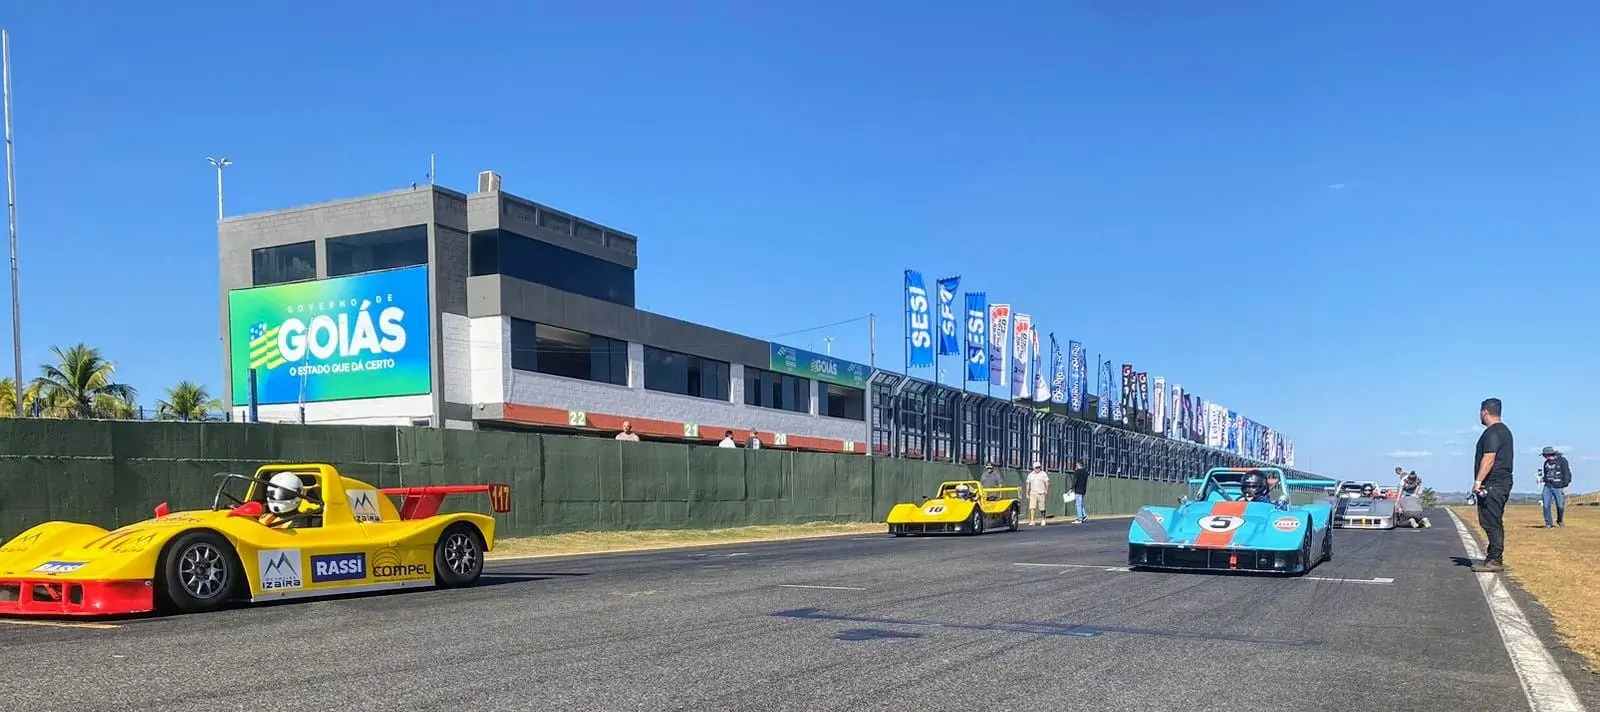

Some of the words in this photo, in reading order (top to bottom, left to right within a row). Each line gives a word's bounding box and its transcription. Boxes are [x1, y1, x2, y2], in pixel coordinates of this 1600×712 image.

[287, 298, 357, 314] GOVERNO
[375, 293, 393, 304] DE
[909, 286, 931, 349] SESI
[277, 299, 407, 362] GOIÁS
[968, 310, 986, 365] SESI
[289, 366, 297, 377] O
[297, 364, 330, 376] ESTADO
[331, 362, 350, 373] QUE
[351, 359, 364, 371] DÁ
[365, 359, 395, 371] CERTO
[816, 359, 838, 376] GOIÁS
[569, 410, 586, 426] 22
[685, 423, 698, 437] 21
[775, 433, 787, 446] 20
[492, 486, 509, 511] 117
[1209, 516, 1230, 529] 5
[373, 564, 431, 577] COMPEL
